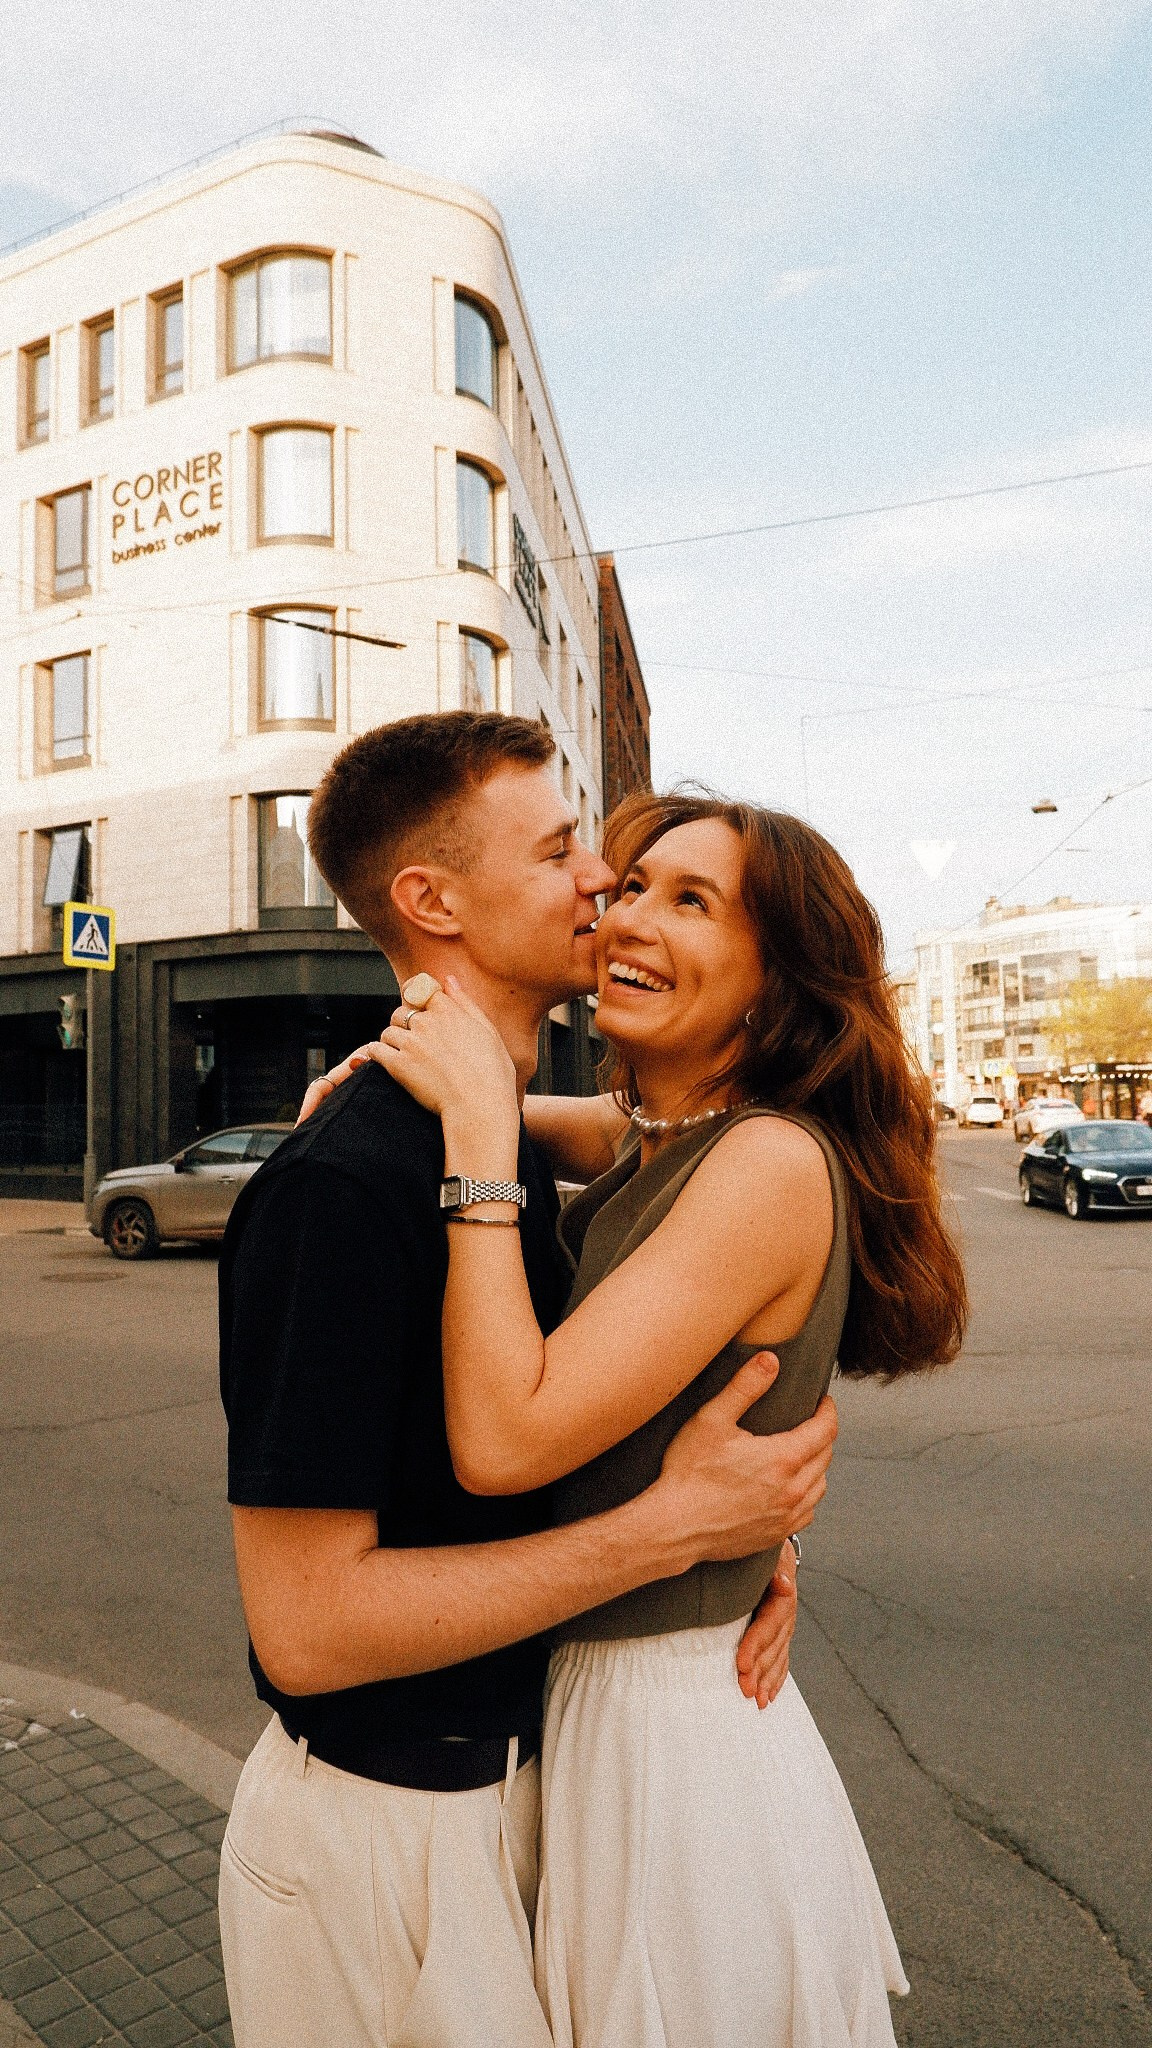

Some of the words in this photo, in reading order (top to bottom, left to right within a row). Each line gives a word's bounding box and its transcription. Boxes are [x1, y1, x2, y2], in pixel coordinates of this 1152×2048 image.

[112, 451, 222, 507] CORNER
[112, 482, 223, 539] PLACE
[111, 539, 166, 564] business
[174, 522, 221, 545] center
